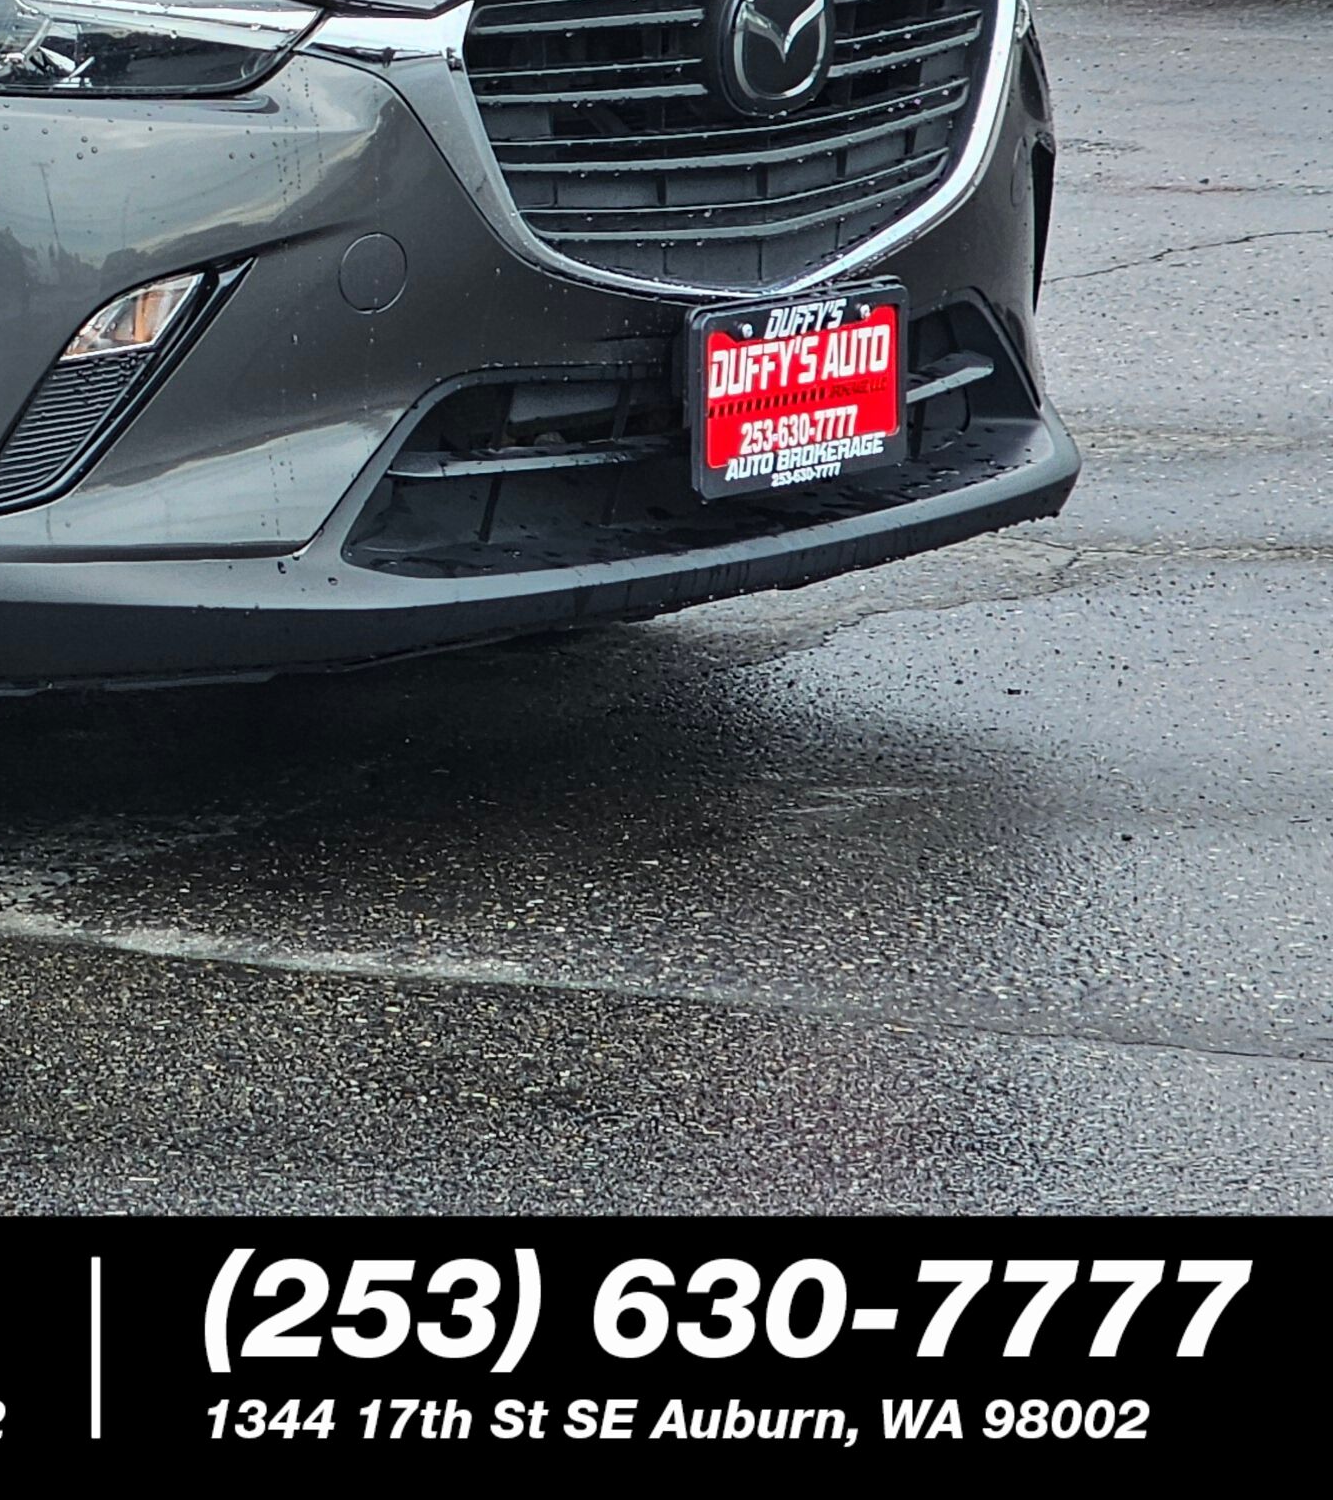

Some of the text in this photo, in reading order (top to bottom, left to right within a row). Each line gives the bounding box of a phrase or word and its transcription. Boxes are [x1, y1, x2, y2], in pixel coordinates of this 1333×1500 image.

[764, 298, 847, 340] DUFFY'S
[708, 325, 891, 399] DUFFY'S AUTO
[739, 404, 858, 455] 253-630-7777
[724, 432, 886, 481] AUTO BROKERAGE
